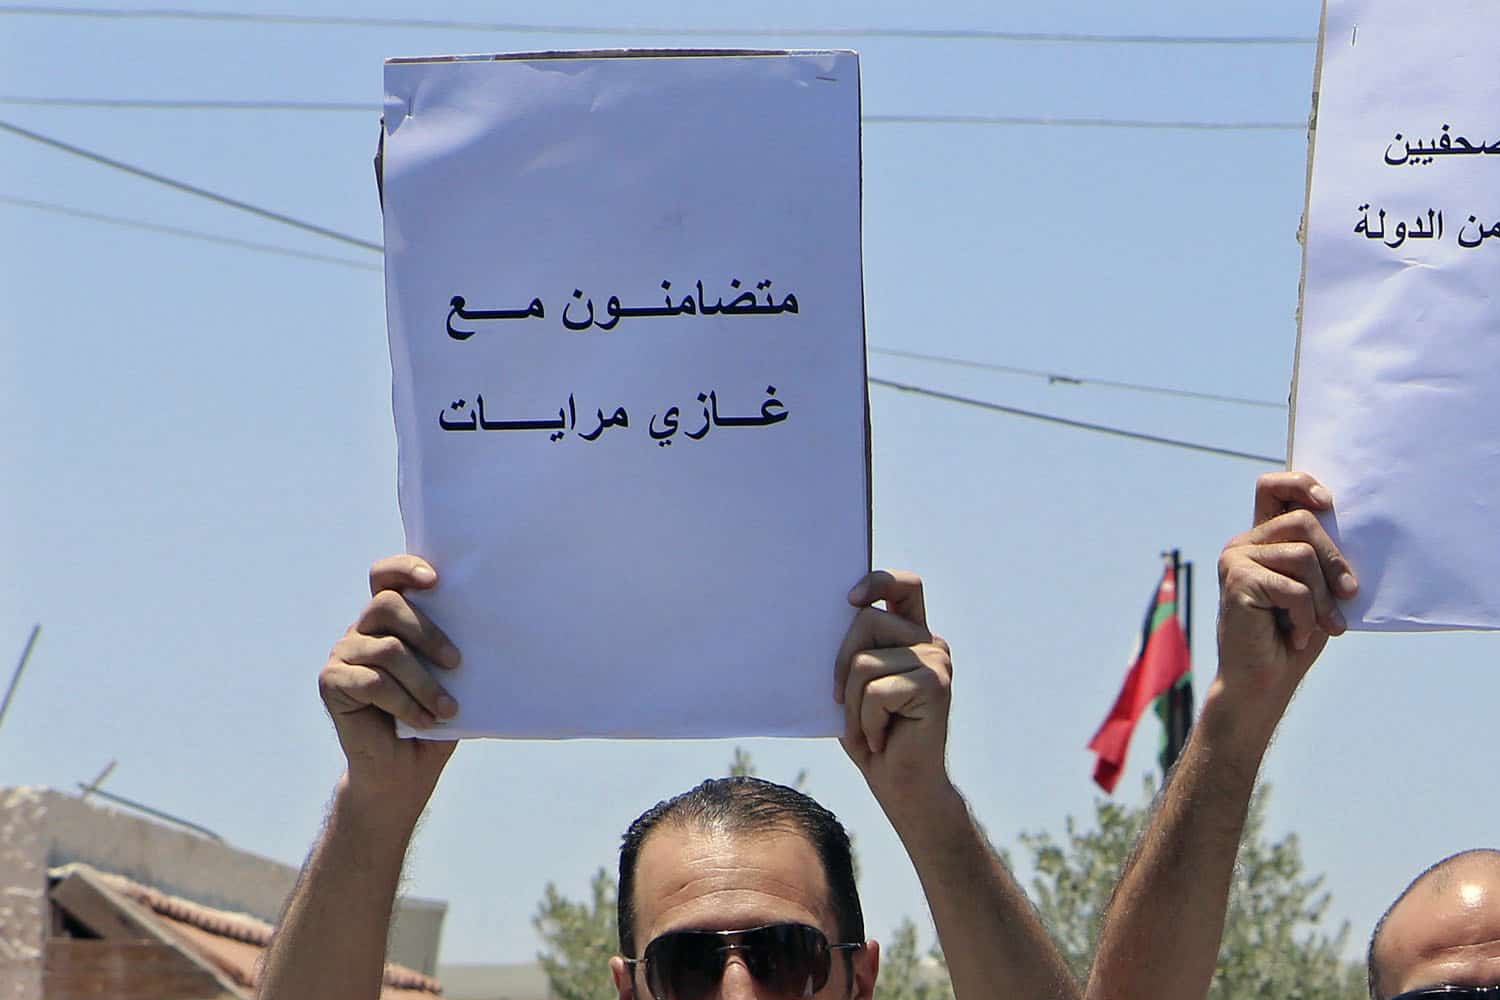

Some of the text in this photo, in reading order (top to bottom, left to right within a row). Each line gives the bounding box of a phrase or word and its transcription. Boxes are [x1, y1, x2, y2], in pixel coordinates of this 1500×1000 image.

[1353, 203, 1443, 248] الدولة
[446, 279, 799, 340] متضامنون مع
[438, 385, 790, 447] غازي مرايات
